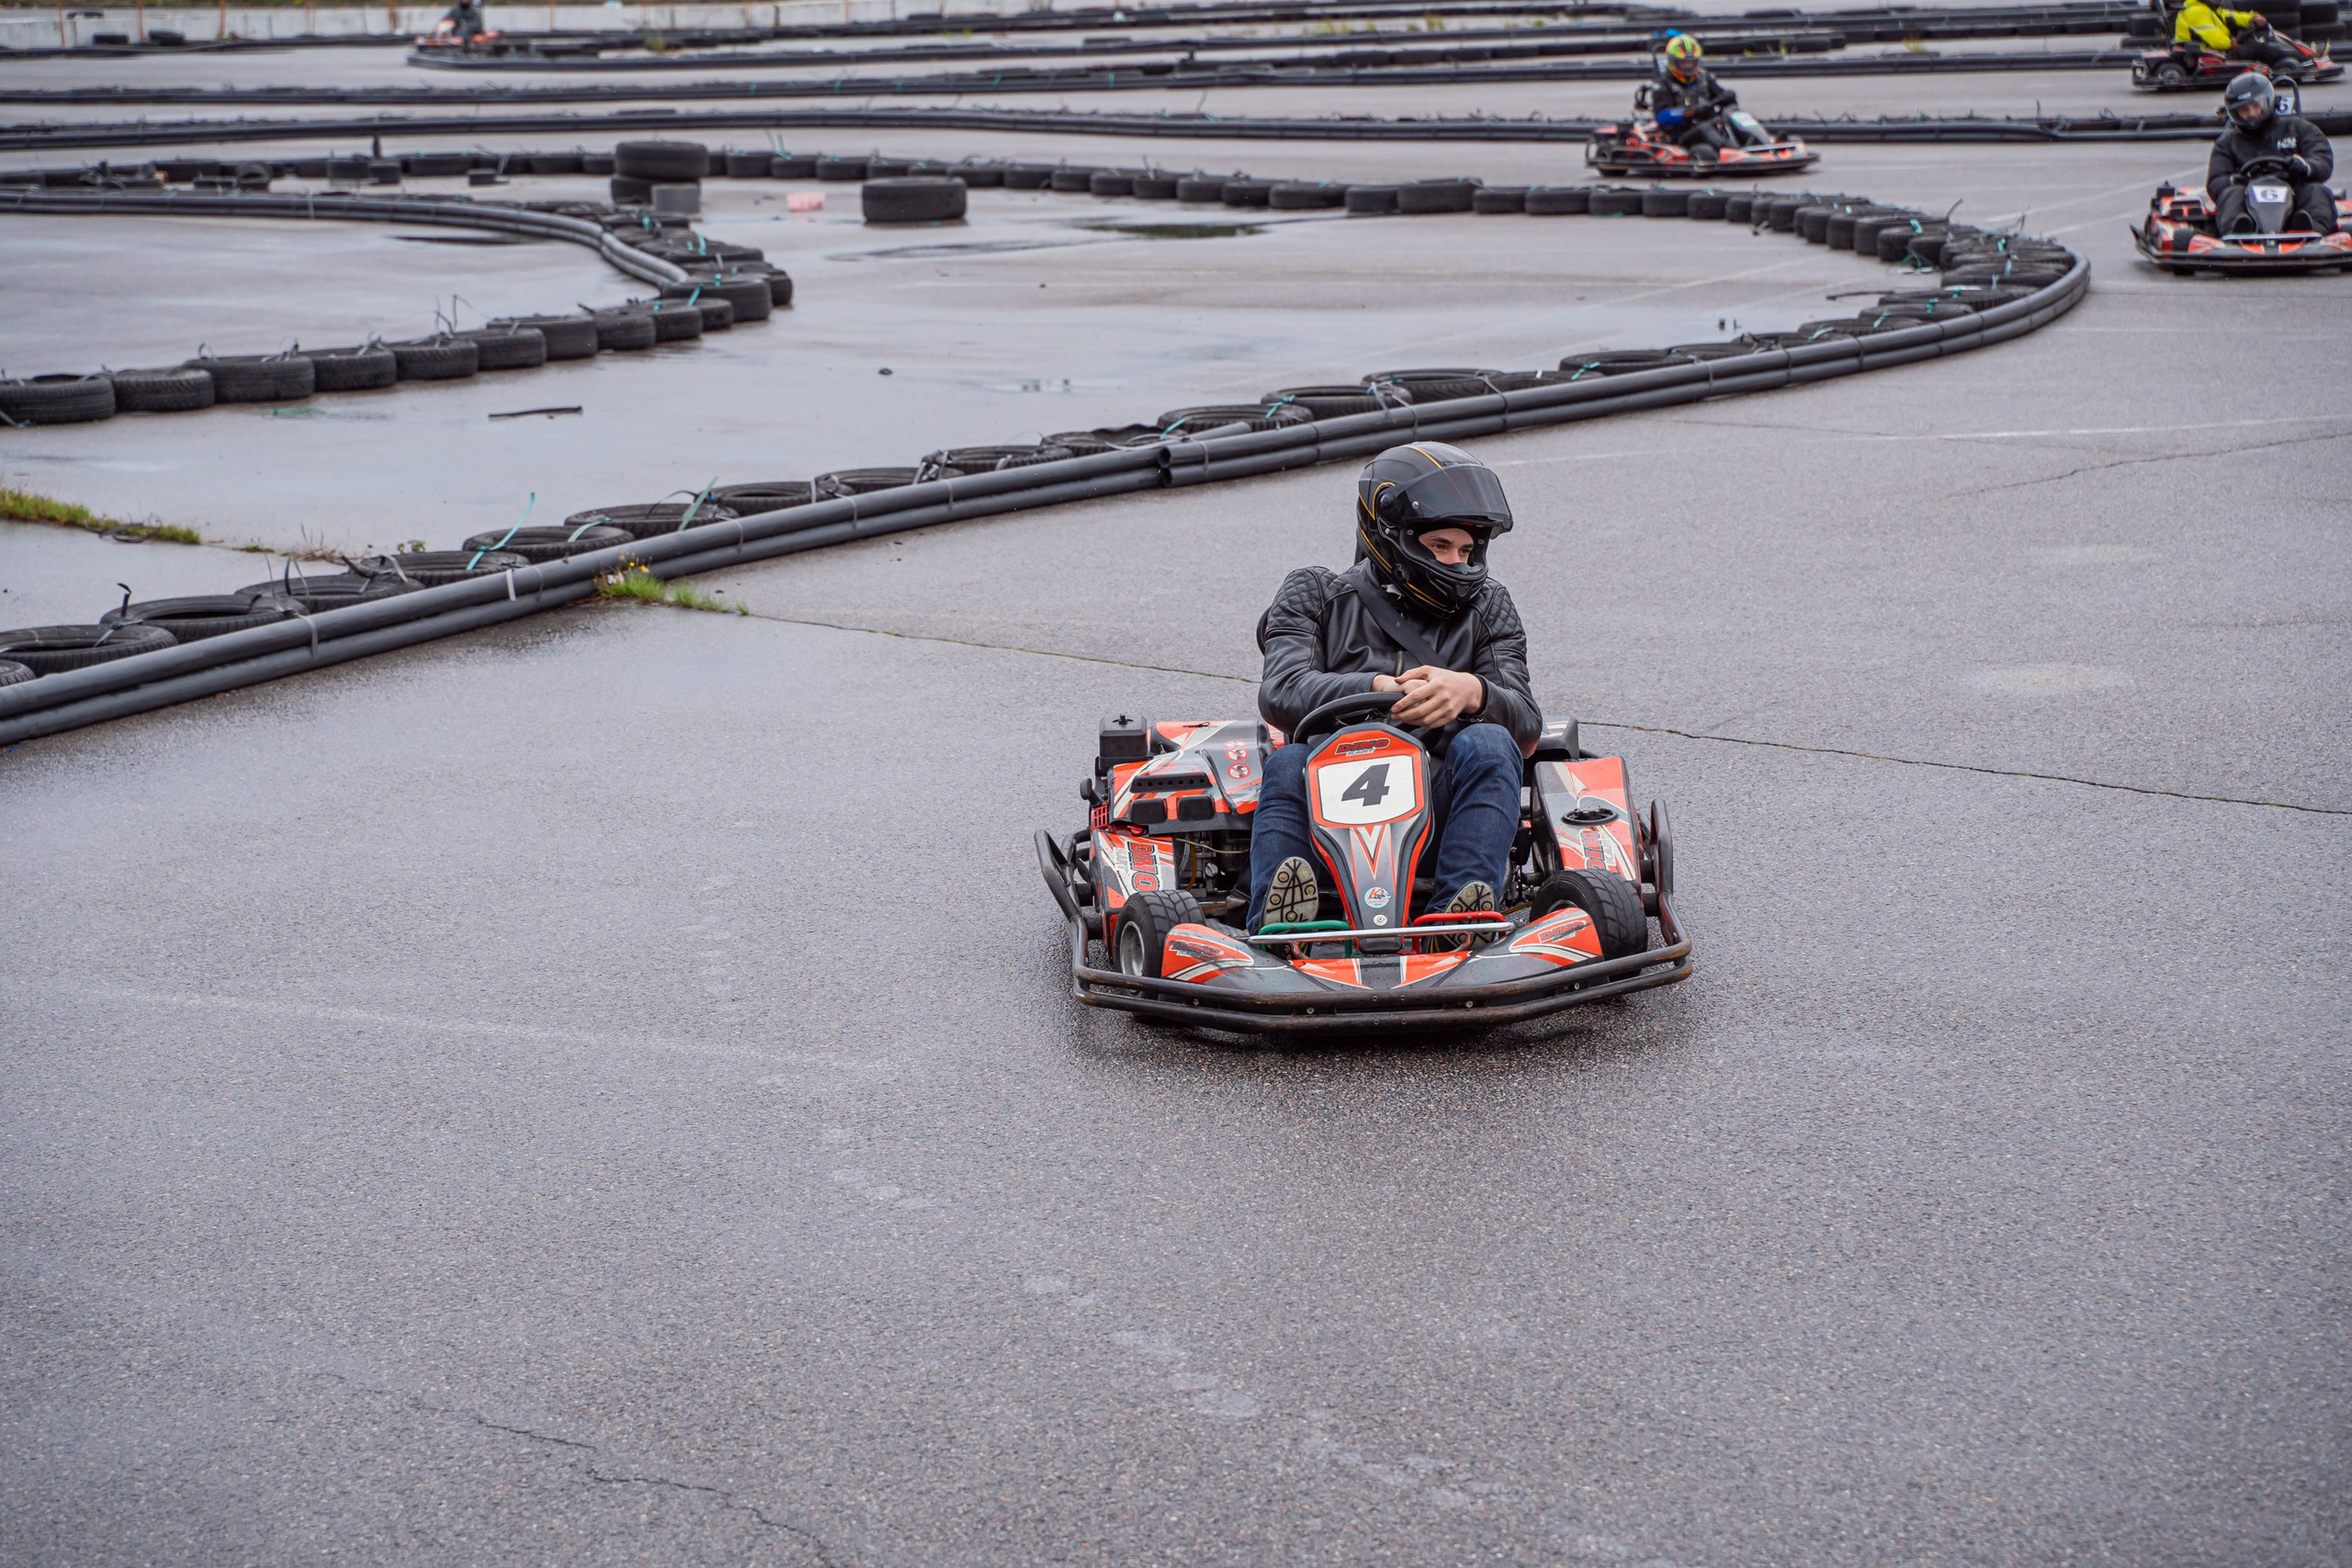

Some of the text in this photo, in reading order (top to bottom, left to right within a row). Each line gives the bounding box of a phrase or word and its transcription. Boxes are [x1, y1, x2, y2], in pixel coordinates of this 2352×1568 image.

[2261, 189, 2278, 200] 6
[1337, 739, 1390, 753] DINO
[1341, 763, 1390, 807] 4
[1127, 841, 1159, 892] DINO
[1539, 921, 1585, 942] DINO
[1170, 941, 1223, 956] DINO
